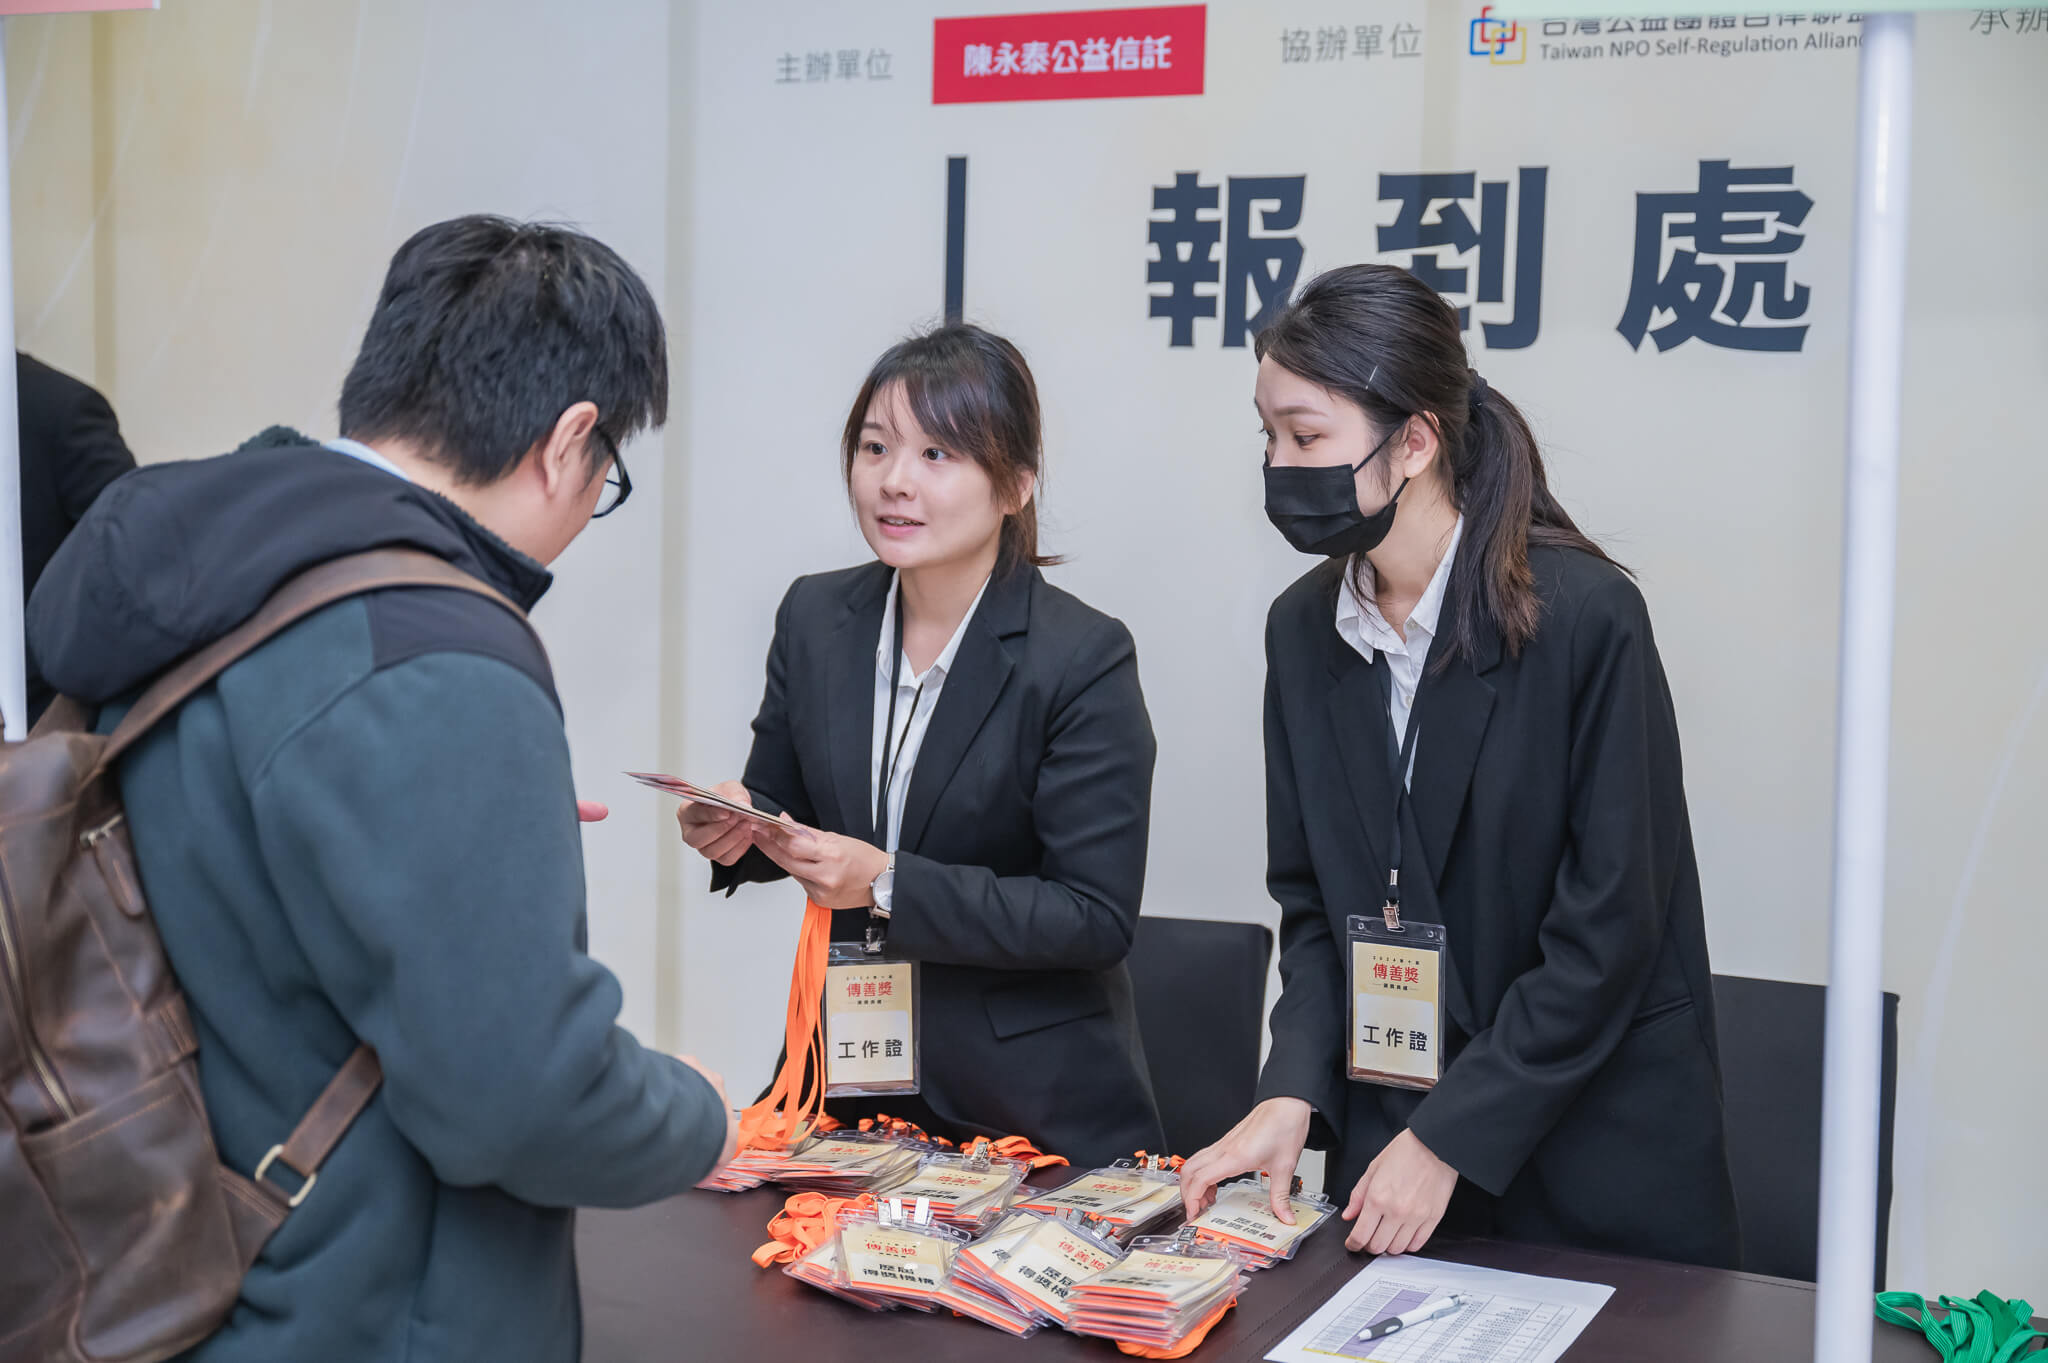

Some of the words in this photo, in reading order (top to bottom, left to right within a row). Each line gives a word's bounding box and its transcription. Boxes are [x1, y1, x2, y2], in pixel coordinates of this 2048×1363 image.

[963, 35, 1172, 78] 陳永泰公益信託
[1280, 22, 1422, 64] 協辦單位
[1540, 42, 1604, 60] Taiwan
[1609, 39, 1651, 57] NPO
[1656, 33, 1798, 56] Self-Regulation
[774, 48, 894, 83] 主辦單位
[1147, 158, 1815, 353] 報到處
[1373, 962, 1419, 984] 傳善獎
[846, 981, 893, 998] 傳善獎
[838, 1039, 903, 1059] 工作證
[1363, 1024, 1428, 1052] 工作證
